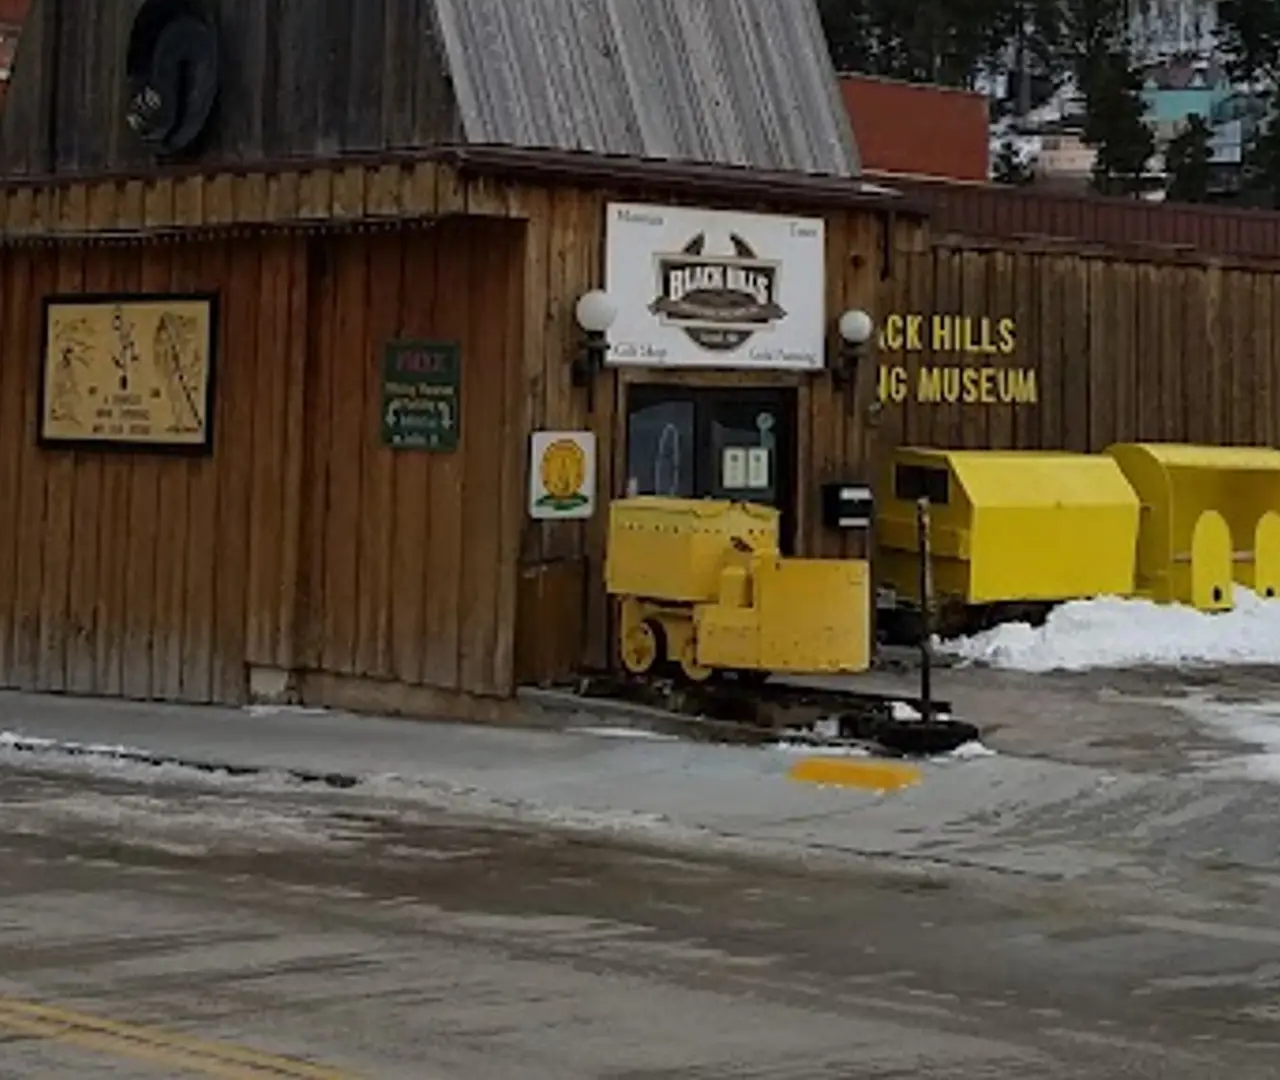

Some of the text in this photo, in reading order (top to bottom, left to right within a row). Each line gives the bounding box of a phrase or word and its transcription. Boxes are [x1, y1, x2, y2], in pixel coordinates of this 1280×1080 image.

[669, 265, 769, 305] BLACK HILLS
[878, 314, 1016, 354] CK HILLS
[917, 366, 1038, 404] MUSEUM
